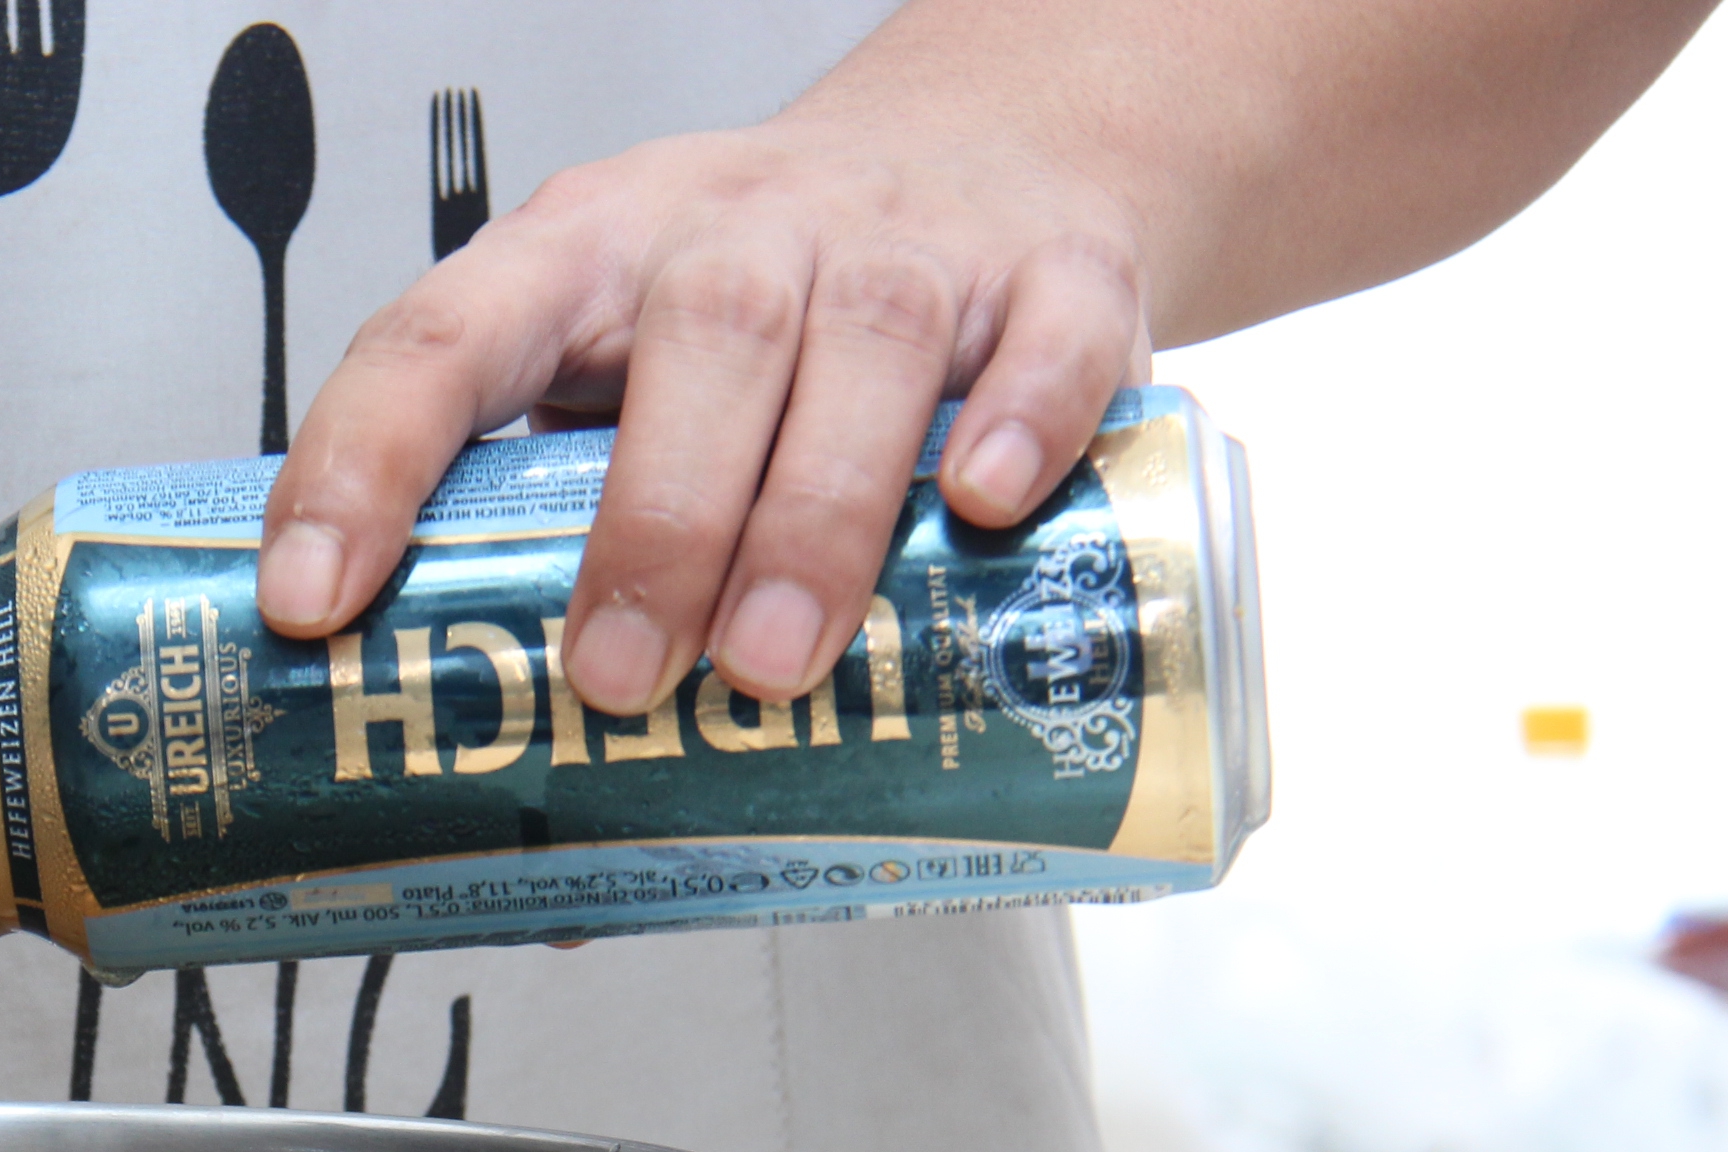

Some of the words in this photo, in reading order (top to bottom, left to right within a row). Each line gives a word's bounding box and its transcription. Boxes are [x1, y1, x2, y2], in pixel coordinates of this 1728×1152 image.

[105, 711, 140, 736] U
[158, 642, 210, 795] UREICH
[217, 641, 246, 790] LUXURIOUS
[401, 883, 453, 903] Plato
[554, 889, 599, 907] Neto
[282, 911, 320, 928] Alk.
[362, 905, 400, 922] 500
